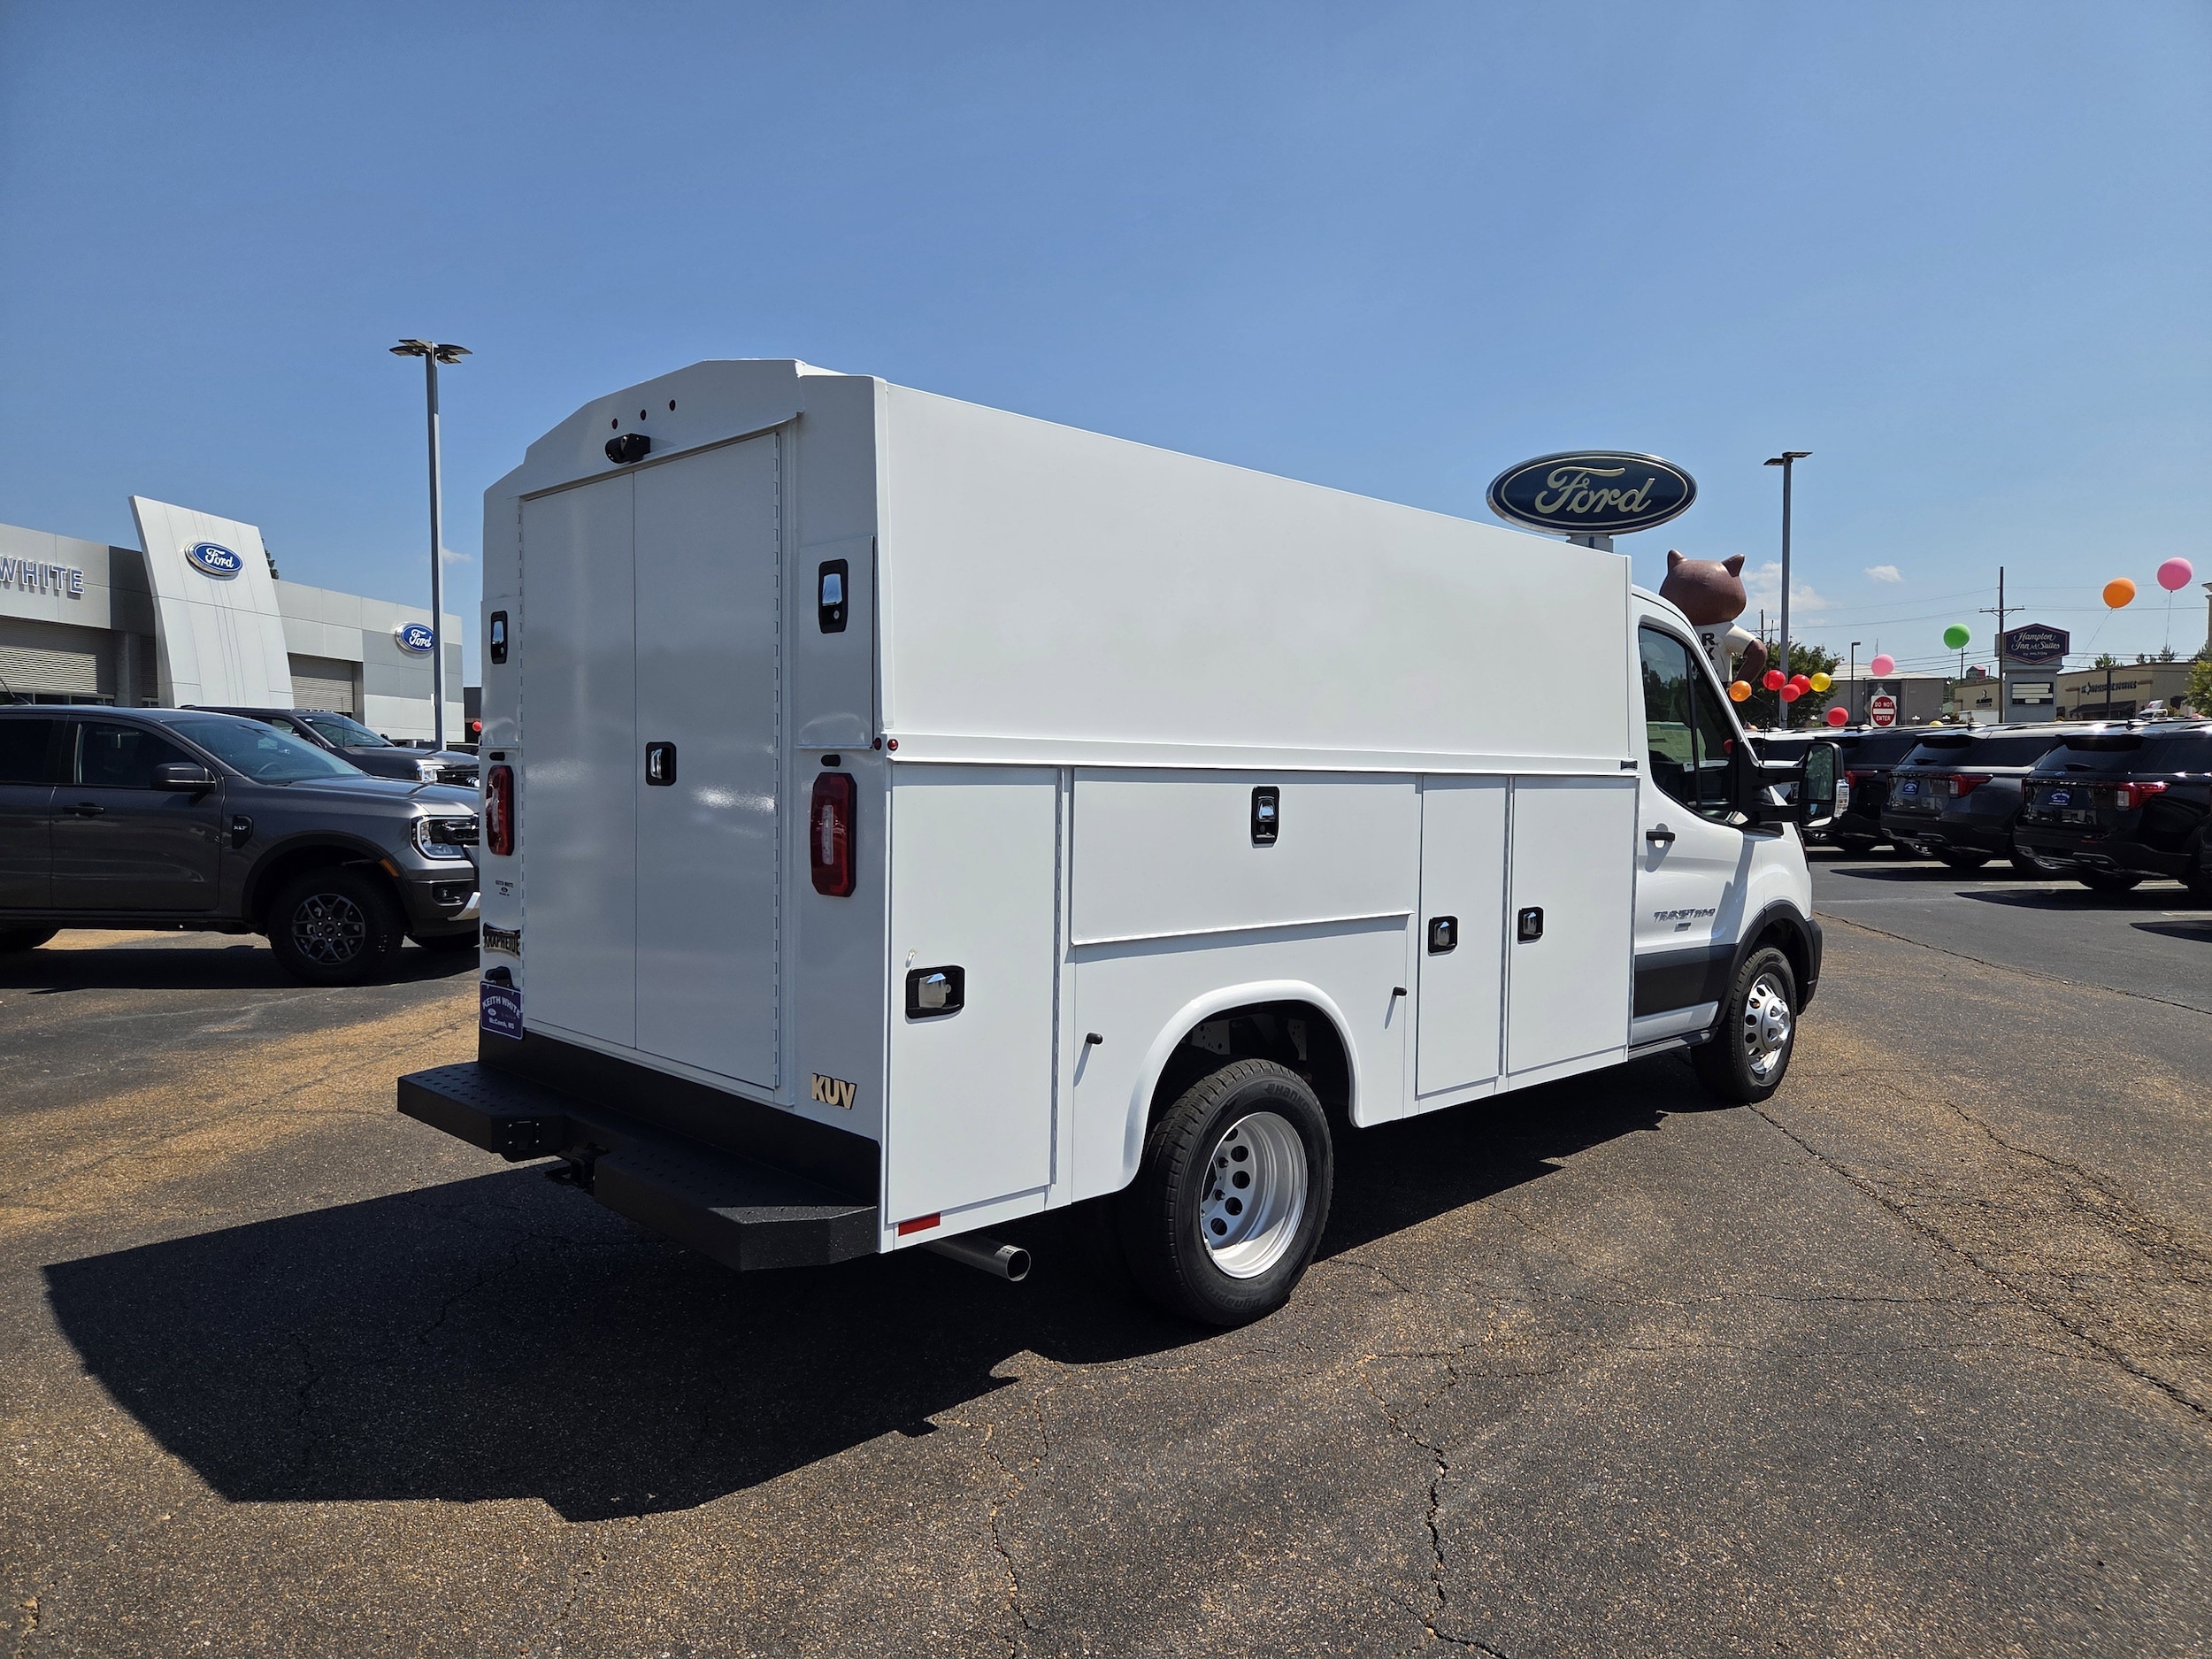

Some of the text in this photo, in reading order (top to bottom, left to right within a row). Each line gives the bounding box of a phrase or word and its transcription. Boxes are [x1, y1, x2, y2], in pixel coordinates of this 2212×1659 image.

[1534, 465, 1655, 514] Ford
[204, 547, 234, 568] Ford
[0, 556, 85, 594] WHITE
[409, 628, 432, 648] Ford
[2011, 641, 2032, 651] Inn
[2038, 641, 2061, 650] Suites
[2013, 631, 2057, 642] Hampton
[482, 995, 501, 1010] KEITH
[501, 996, 521, 1019] WHITE
[811, 1072, 857, 1110] KUV
